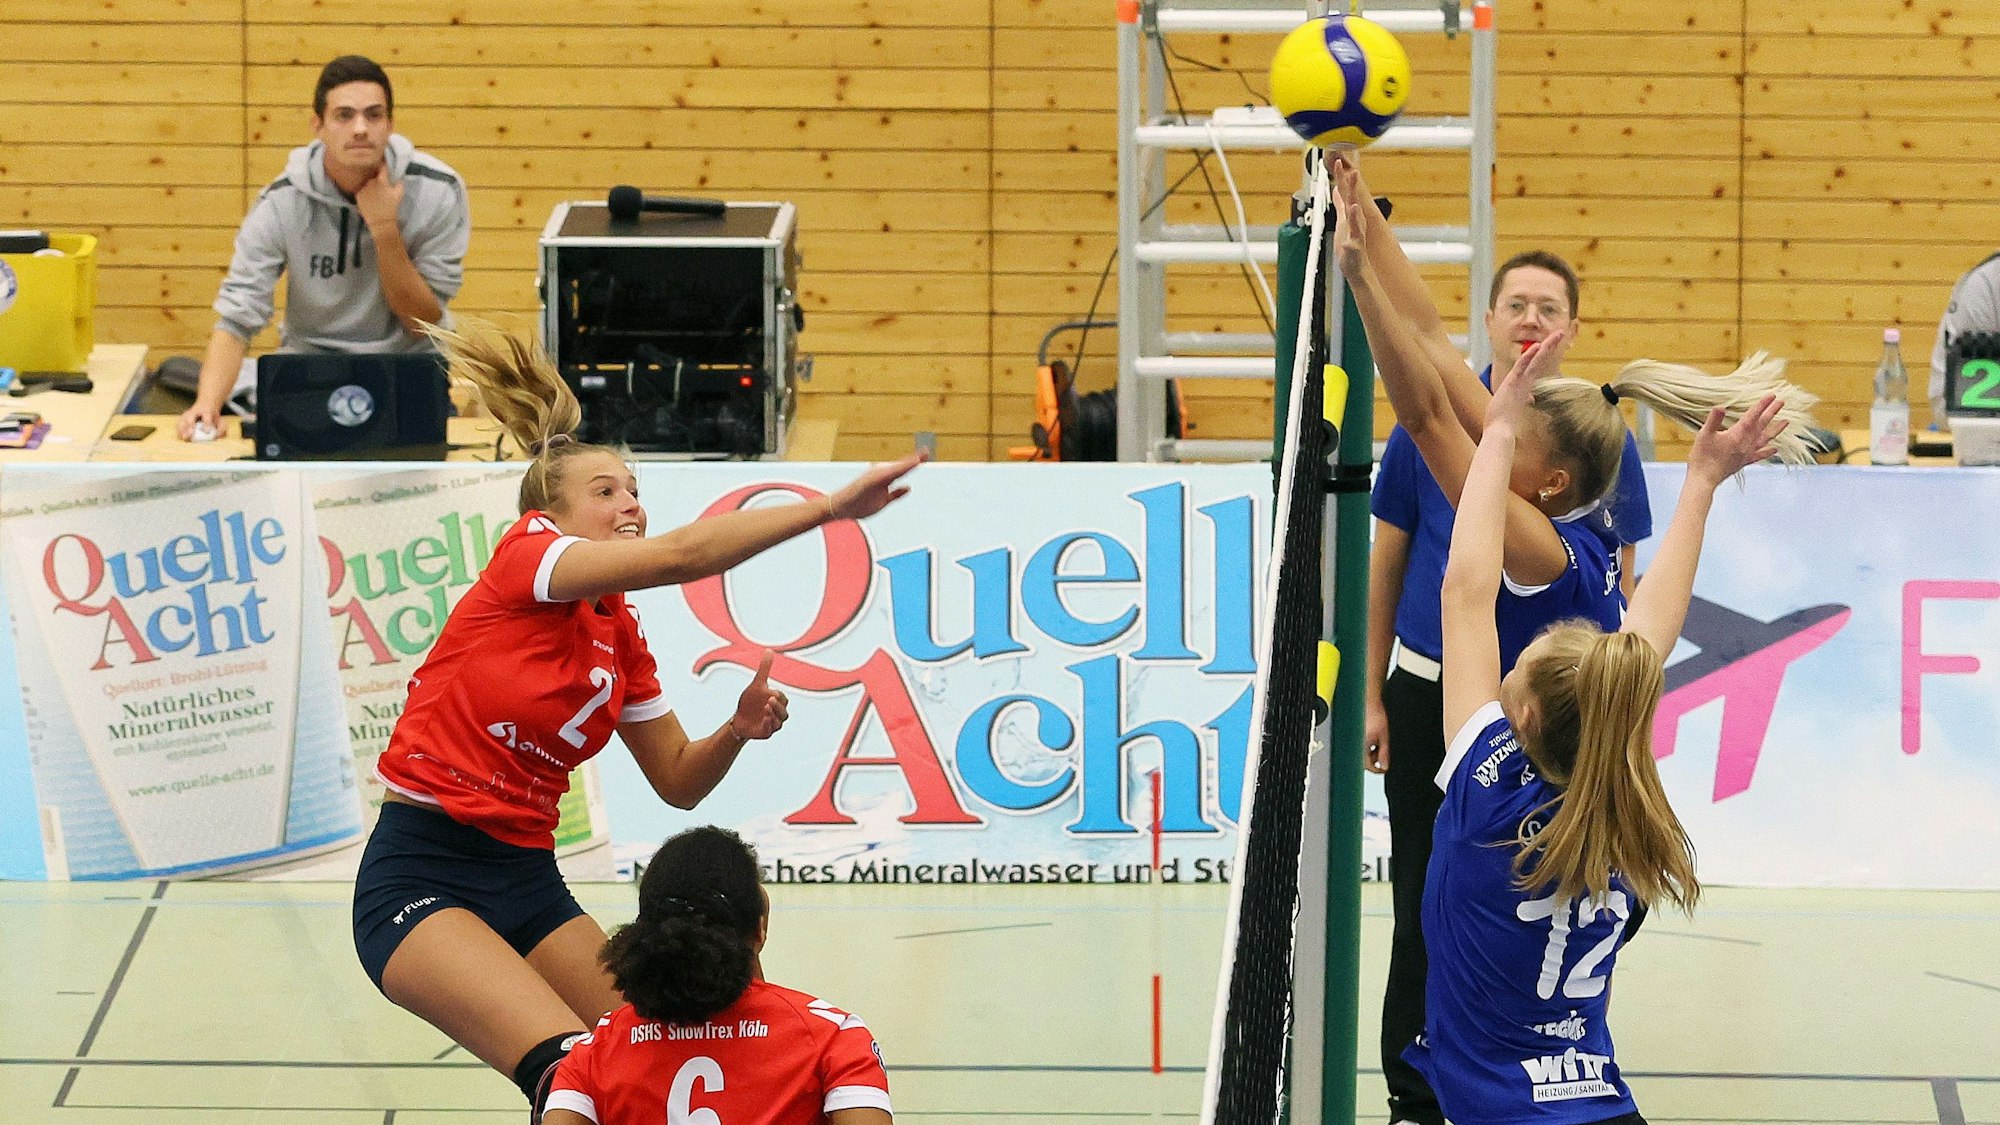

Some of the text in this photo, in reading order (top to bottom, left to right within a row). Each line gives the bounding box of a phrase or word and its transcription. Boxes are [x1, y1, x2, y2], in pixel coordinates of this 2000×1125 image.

[43, 508, 287, 615] Quelle
[91, 583, 275, 670] Acht
[122, 685, 256, 719] Natürliches
[1901, 579, 2000, 756] F
[108, 701, 275, 740] Mineralwasser
[557, 666, 613, 749] 2
[850, 857, 1098, 883] Mineralwasser
[1516, 890, 1630, 1000] 12
[630, 1019, 768, 1044] DSHS SnowTrex Köln
[667, 1055, 724, 1125] 6
